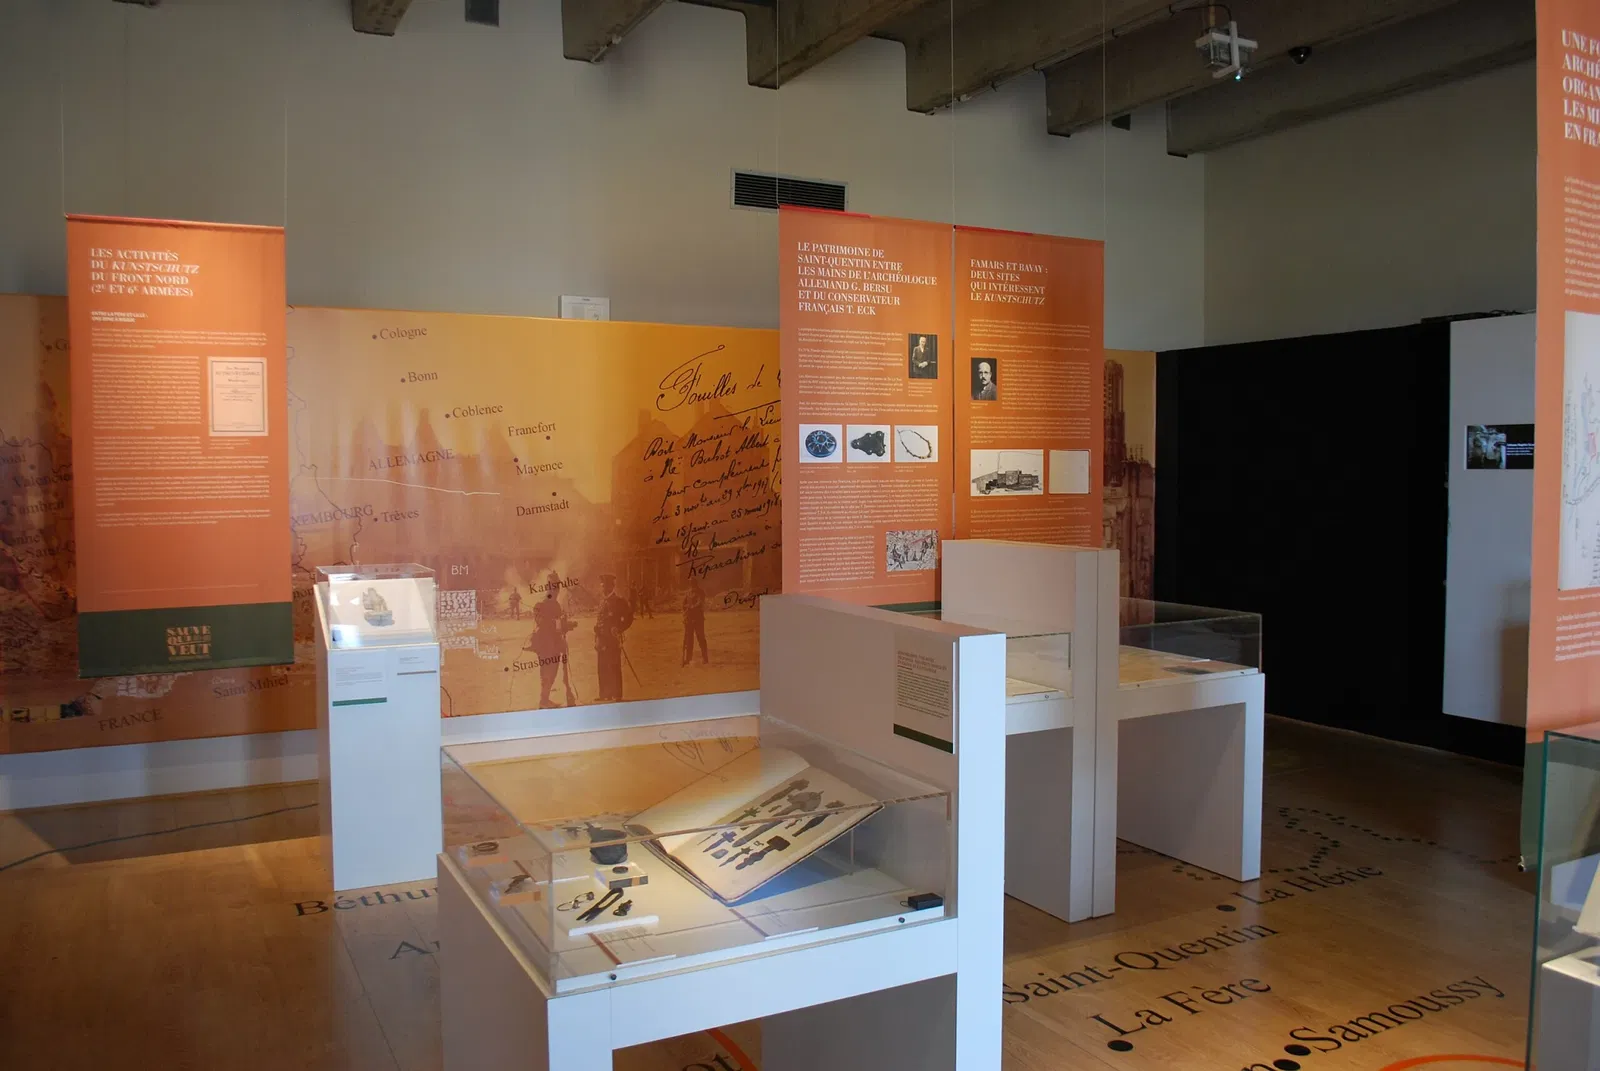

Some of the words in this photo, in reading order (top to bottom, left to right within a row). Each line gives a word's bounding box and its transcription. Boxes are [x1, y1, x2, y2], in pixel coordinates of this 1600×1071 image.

[1561, 28, 1587, 52] UNE
[1562, 97, 1585, 119] LES
[1563, 121, 1581, 141] EN
[91, 248, 113, 258] LES
[116, 249, 179, 261] ACTIVITÉS
[798, 242, 810, 252] LE
[812, 243, 870, 257] PATRIMOINE
[872, 249, 884, 259] DE
[91, 260, 107, 270] DU
[111, 261, 200, 275] KUNSTSCHUTZ
[797, 254, 871, 269] SAINT-QUENTIN
[872, 260, 903, 272] ENTRE
[970, 258, 1004, 270] FAMARS
[1006, 262, 1016, 271] ET
[1019, 263, 1044, 274] BAVAY
[91, 272, 107, 282] DU
[111, 274, 152, 284] FRONT
[155, 275, 189, 285] NORD
[798, 266, 816, 276] LES
[817, 267, 846, 278] MAINS
[848, 270, 861, 279] DE
[863, 271, 937, 285] L'ARCHÉOLOGUE
[970, 270, 995, 281] DEUX
[996, 272, 1020, 282] SITES
[109, 285, 124, 295] ET
[142, 284, 194, 297] ARMÉES)
[798, 278, 849, 291] ALLEMAND
[851, 281, 861, 291] G.
[863, 283, 892, 294] BERSU
[970, 281, 987, 292] QUI
[988, 281, 1046, 295] INTÉRESSENT
[798, 290, 811, 300] ET
[813, 291, 826, 301] DU
[828, 292, 901, 306] CONSERVATEUR
[970, 292, 982, 301] LE
[984, 293, 1046, 305] KUNSTSCHUTZ
[798, 301, 845, 315] FRANÇAIS
[846, 304, 855, 314] T.
[857, 305, 876, 316] ECK
[379, 326, 428, 341] Cologne
[407, 371, 439, 383] Bonn
[452, 403, 504, 419] Coblence
[507, 422, 557, 437] Francfort
[368, 448, 455, 472] ALLEMAGNE
[516, 461, 563, 477] Mayence
[380, 508, 420, 524] Trèves
[516, 499, 570, 517] Darmstadt
[730, 509, 742, 520] 25
[451, 564, 469, 576] BM
[529, 577, 580, 595] Karlsruhe
[167, 625, 211, 636] SAUVE
[168, 644, 212, 656] VEUT
[512, 652, 568, 673] Strasbourg
[98, 708, 164, 732] FRANCE
[1234, 886, 1284, 905] La
[1285, 863, 1384, 893] Hérie
[293, 887, 438, 917] Béthu
[1003, 923, 1281, 1006] Saint-Quentin
[1089, 1007, 1173, 1038] La
[1157, 975, 1273, 1016] Fère
[1288, 975, 1505, 1054] Samoussy
